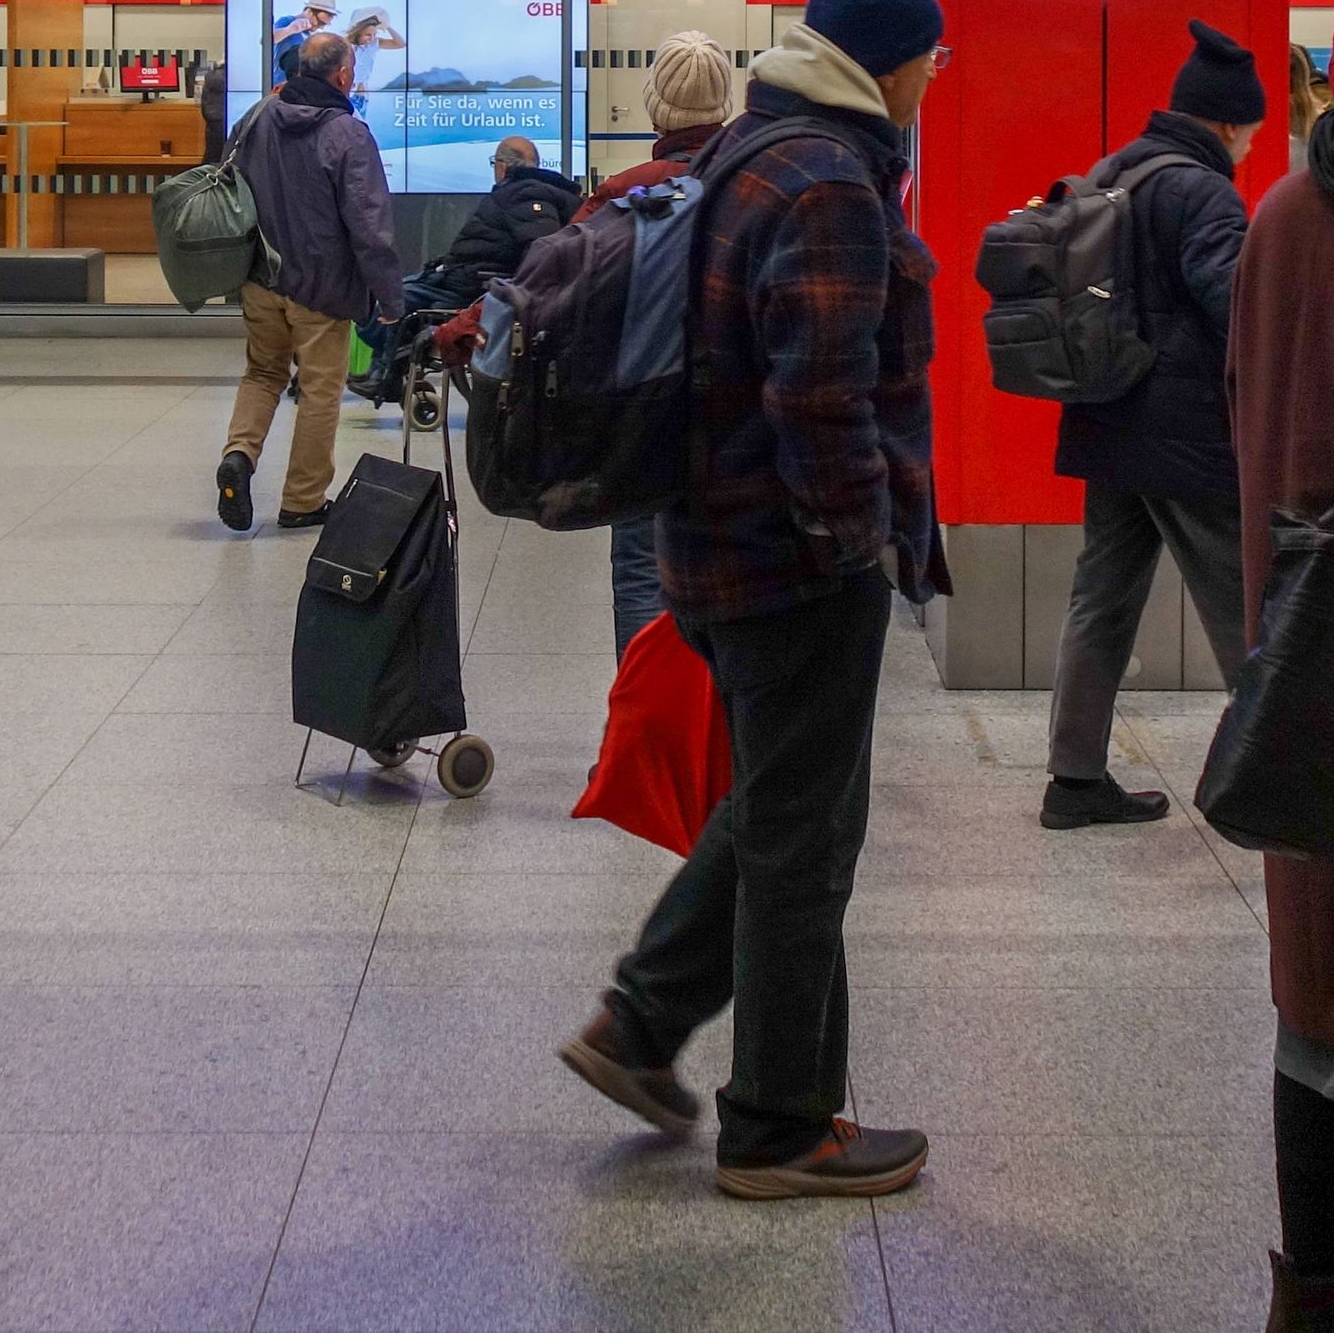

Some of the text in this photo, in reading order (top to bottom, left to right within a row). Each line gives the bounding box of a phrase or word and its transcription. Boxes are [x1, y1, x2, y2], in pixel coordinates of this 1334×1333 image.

[394, 95, 556, 111] Für Sie da, wenn es
[394, 112, 545, 127] Zeit für Urlaub ist.
